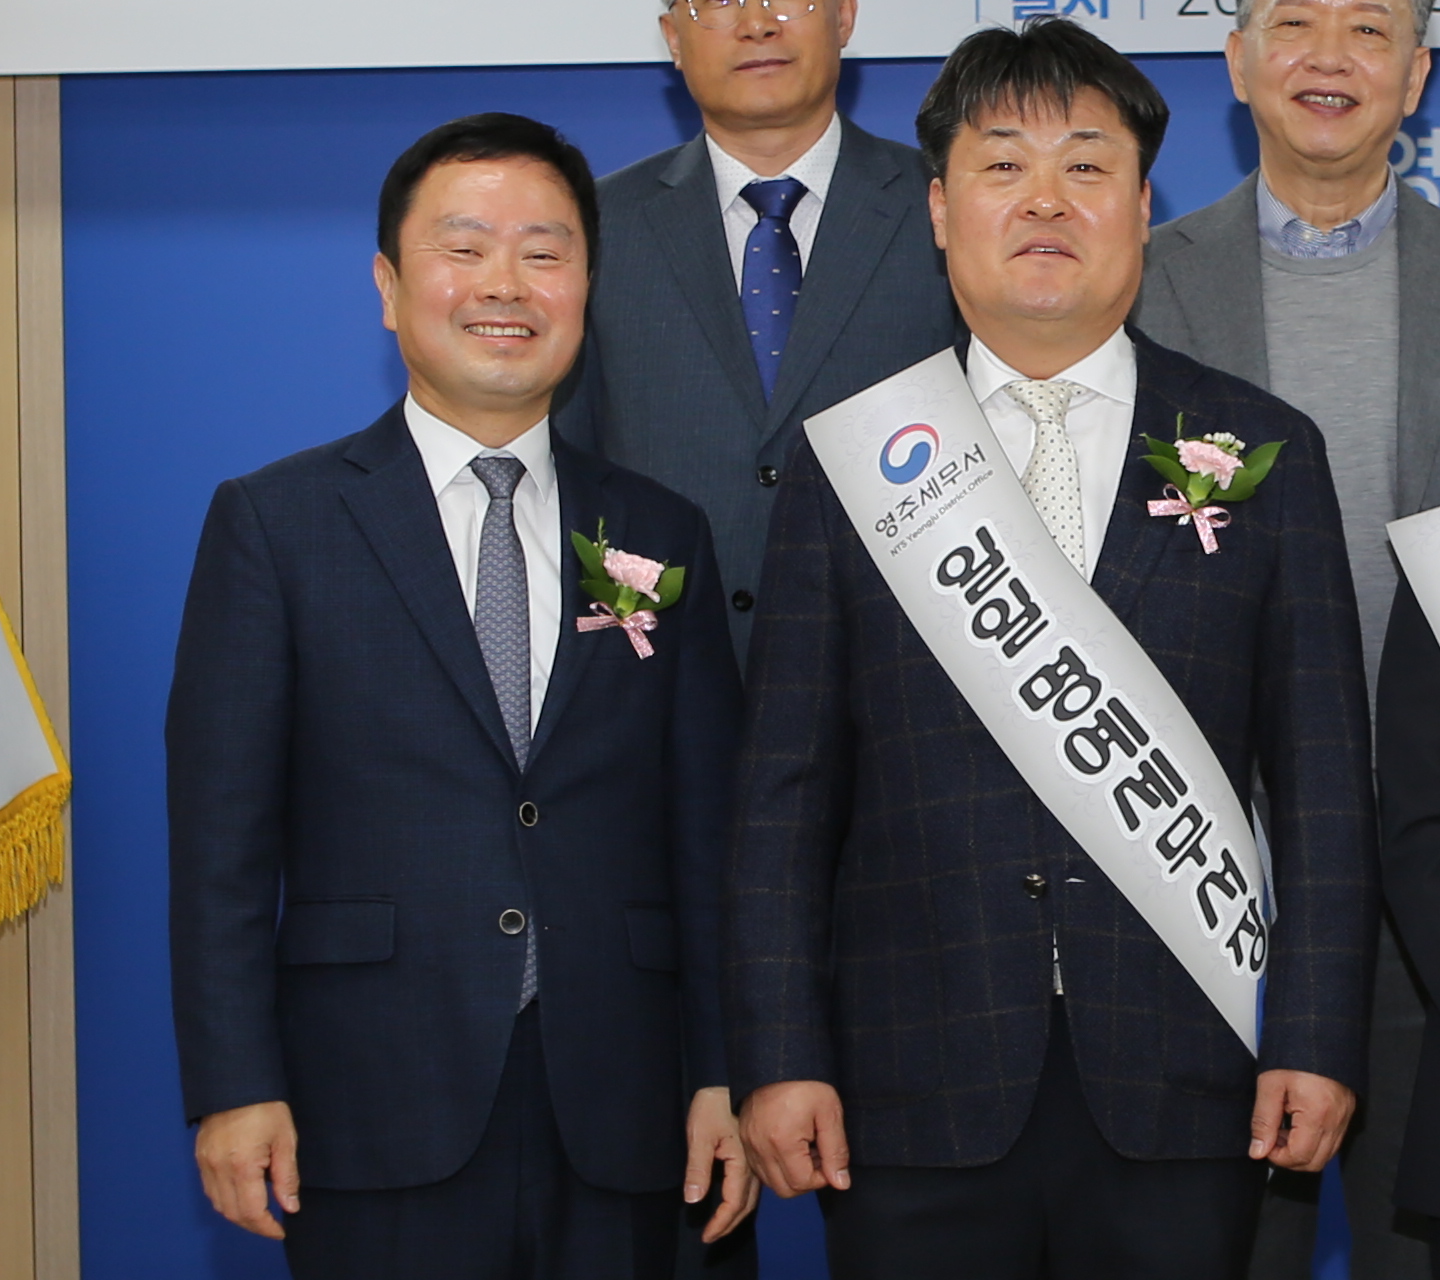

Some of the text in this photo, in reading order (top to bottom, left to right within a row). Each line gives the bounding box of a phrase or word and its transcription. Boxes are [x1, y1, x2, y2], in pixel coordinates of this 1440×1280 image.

[874, 442, 987, 538] 영주세무서
[889, 469, 994, 558] NTS Yeongju District Office
[936, 525, 1267, 973] 일일 명예세무서장
